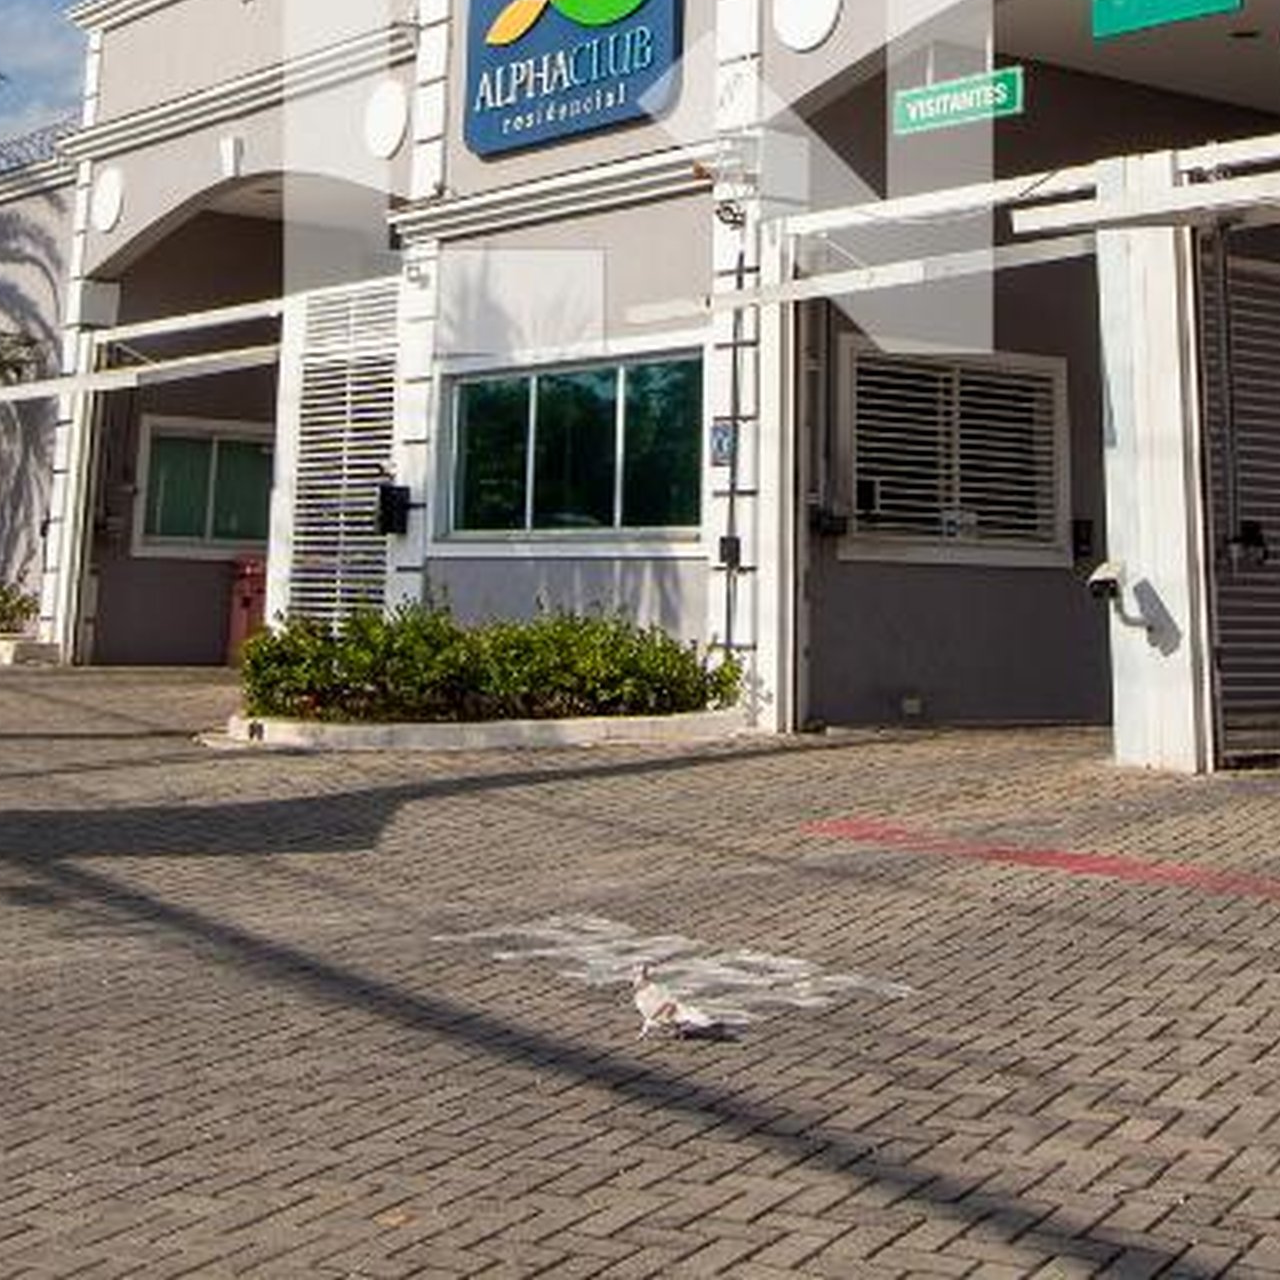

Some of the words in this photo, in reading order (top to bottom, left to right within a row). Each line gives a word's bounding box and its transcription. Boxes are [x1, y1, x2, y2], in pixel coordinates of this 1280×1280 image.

[474, 26, 654, 112] ALPHACLUB
[502, 82, 626, 135] residencial
[905, 81, 1009, 121] VISITANTES
